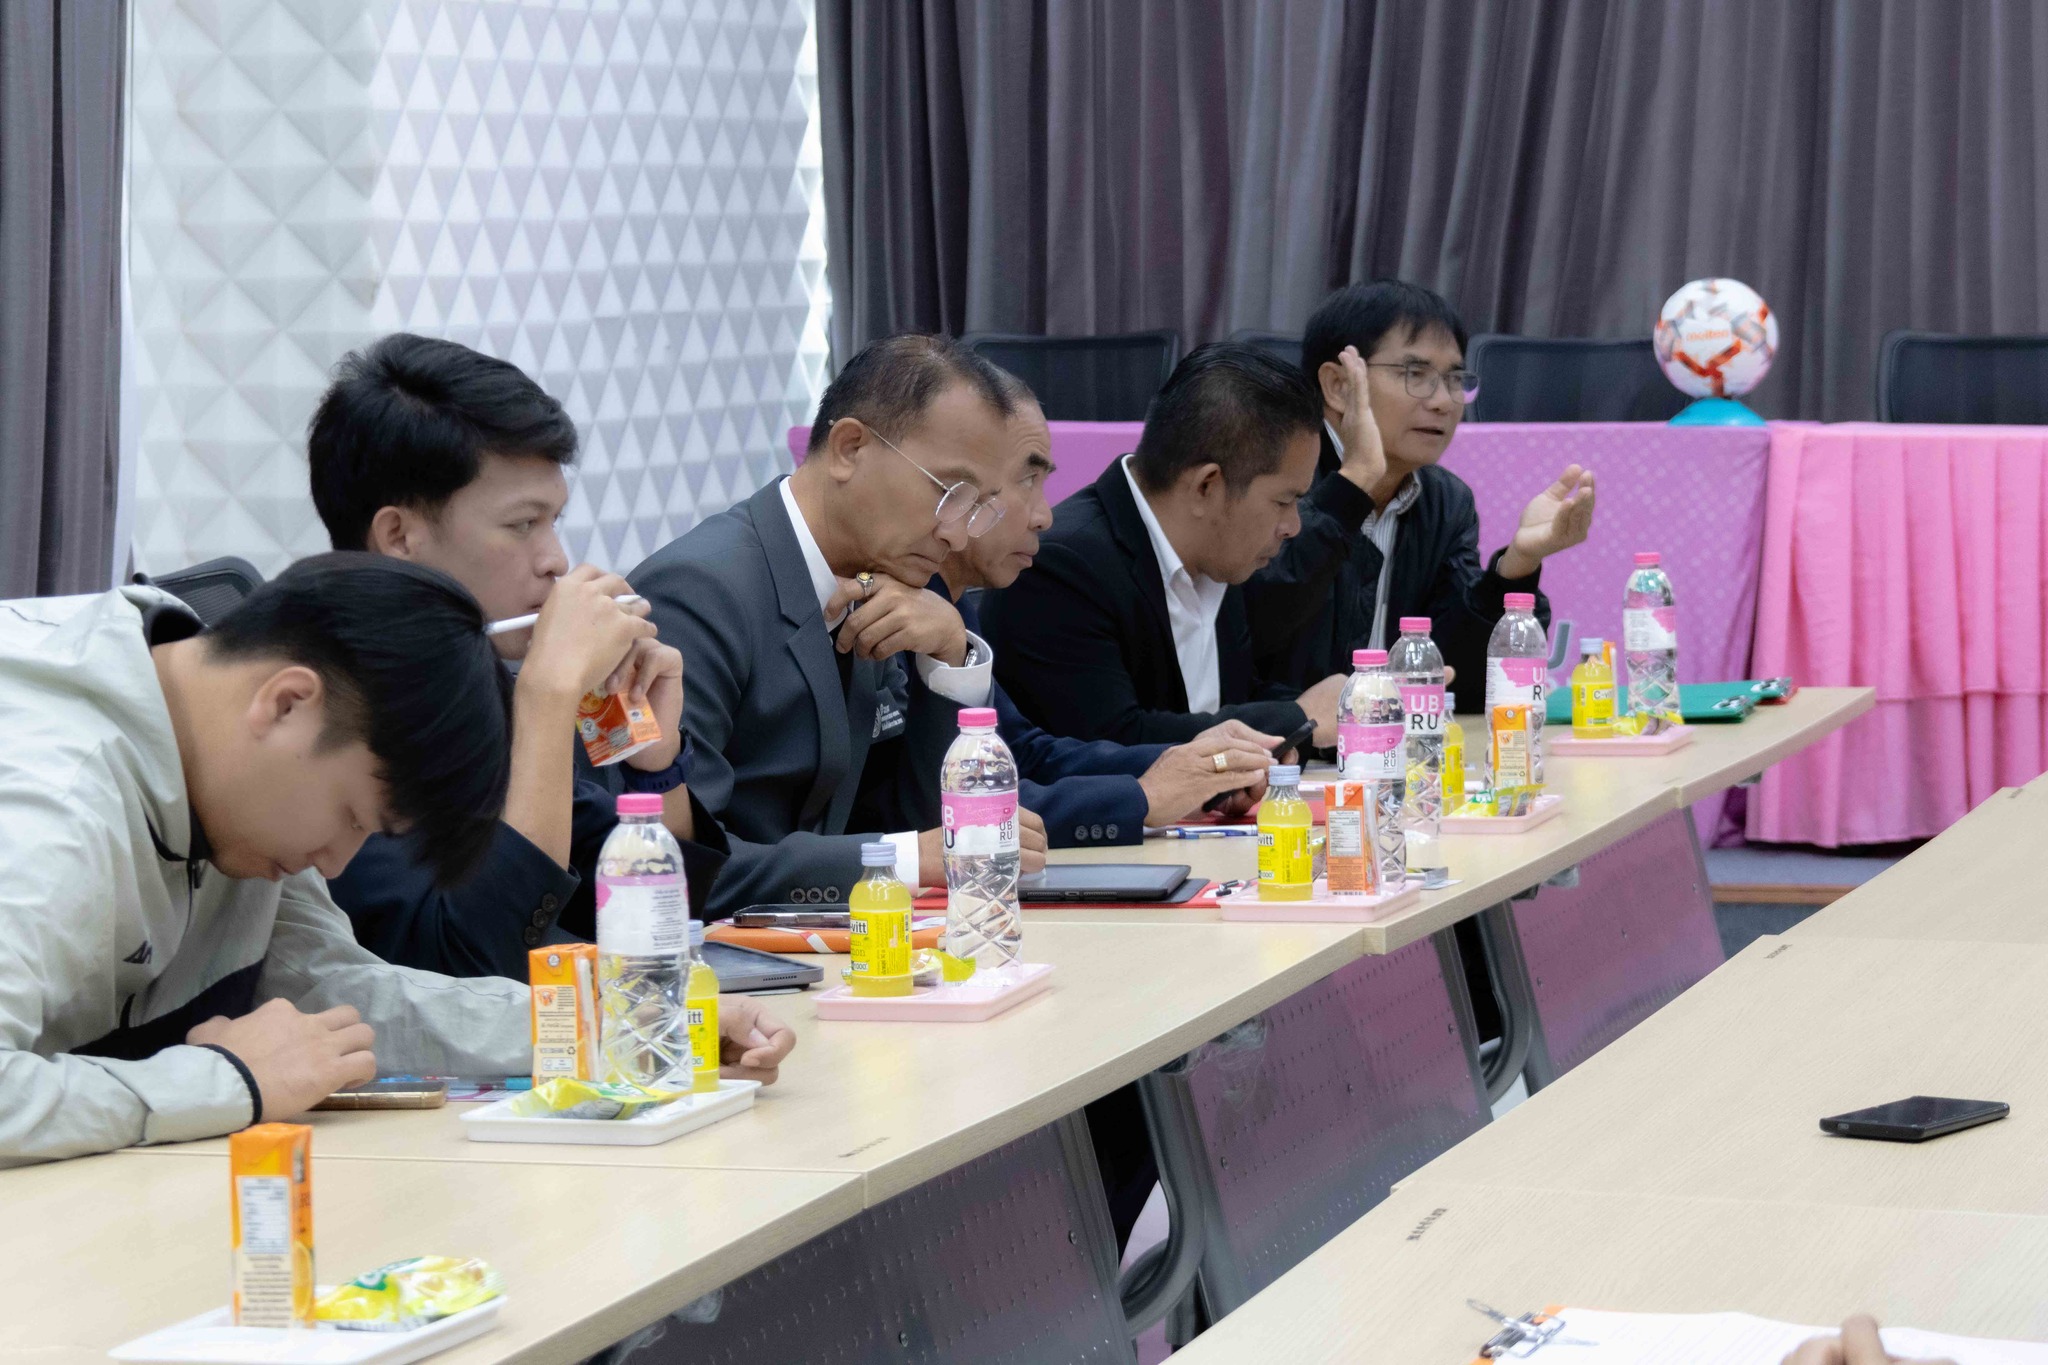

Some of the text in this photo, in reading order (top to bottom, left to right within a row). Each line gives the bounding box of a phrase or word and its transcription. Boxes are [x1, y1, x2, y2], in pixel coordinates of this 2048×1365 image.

[1410, 695, 1439, 713] UB
[1411, 713, 1438, 730] RU
[1000, 831, 1013, 841] RU
